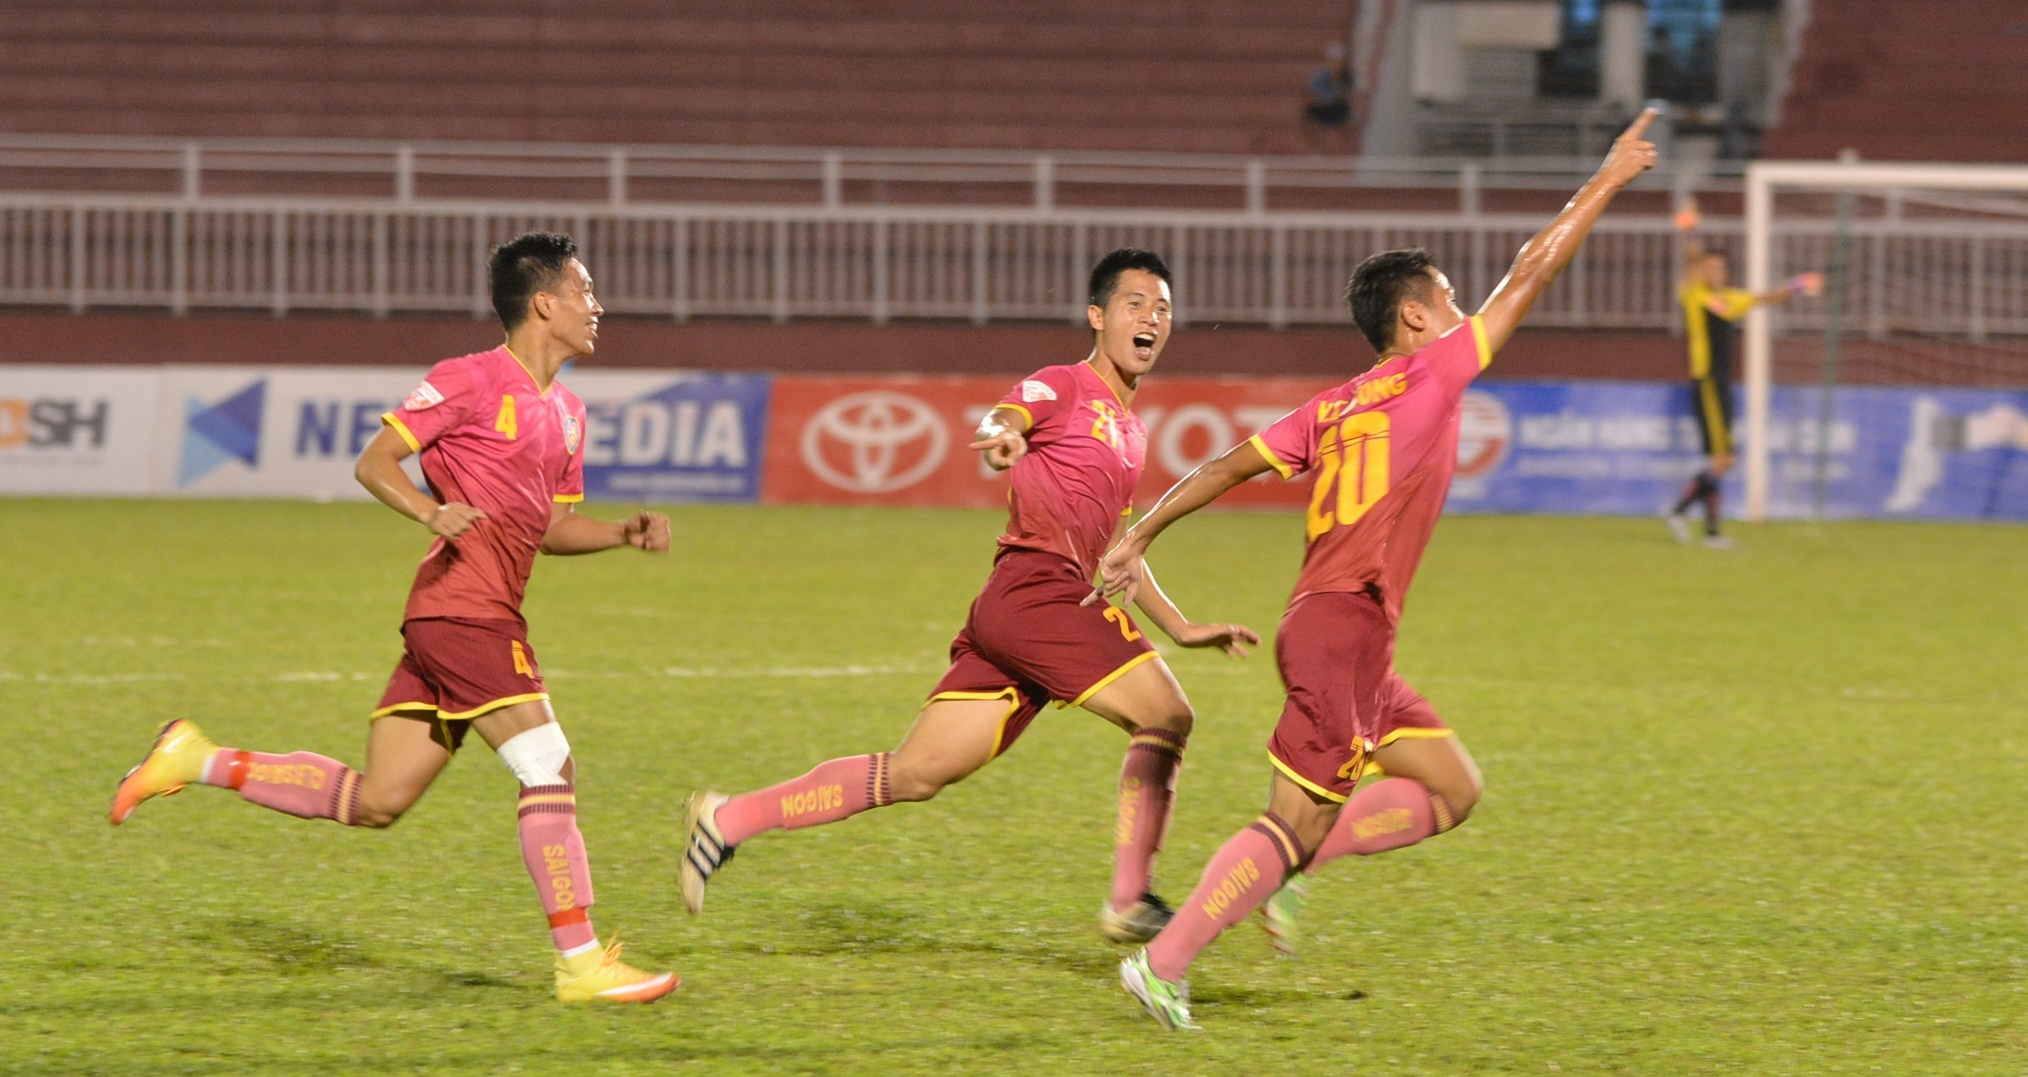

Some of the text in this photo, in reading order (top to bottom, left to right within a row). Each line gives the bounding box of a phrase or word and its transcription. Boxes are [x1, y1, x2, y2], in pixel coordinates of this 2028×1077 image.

[495, 394, 518, 440] 4
[1091, 399, 1118, 449] 21
[1305, 411, 1392, 542] 20
[511, 639, 536, 679] 4
[780, 784, 844, 819] SAIGON
[1200, 856, 1262, 921] SAIGON
